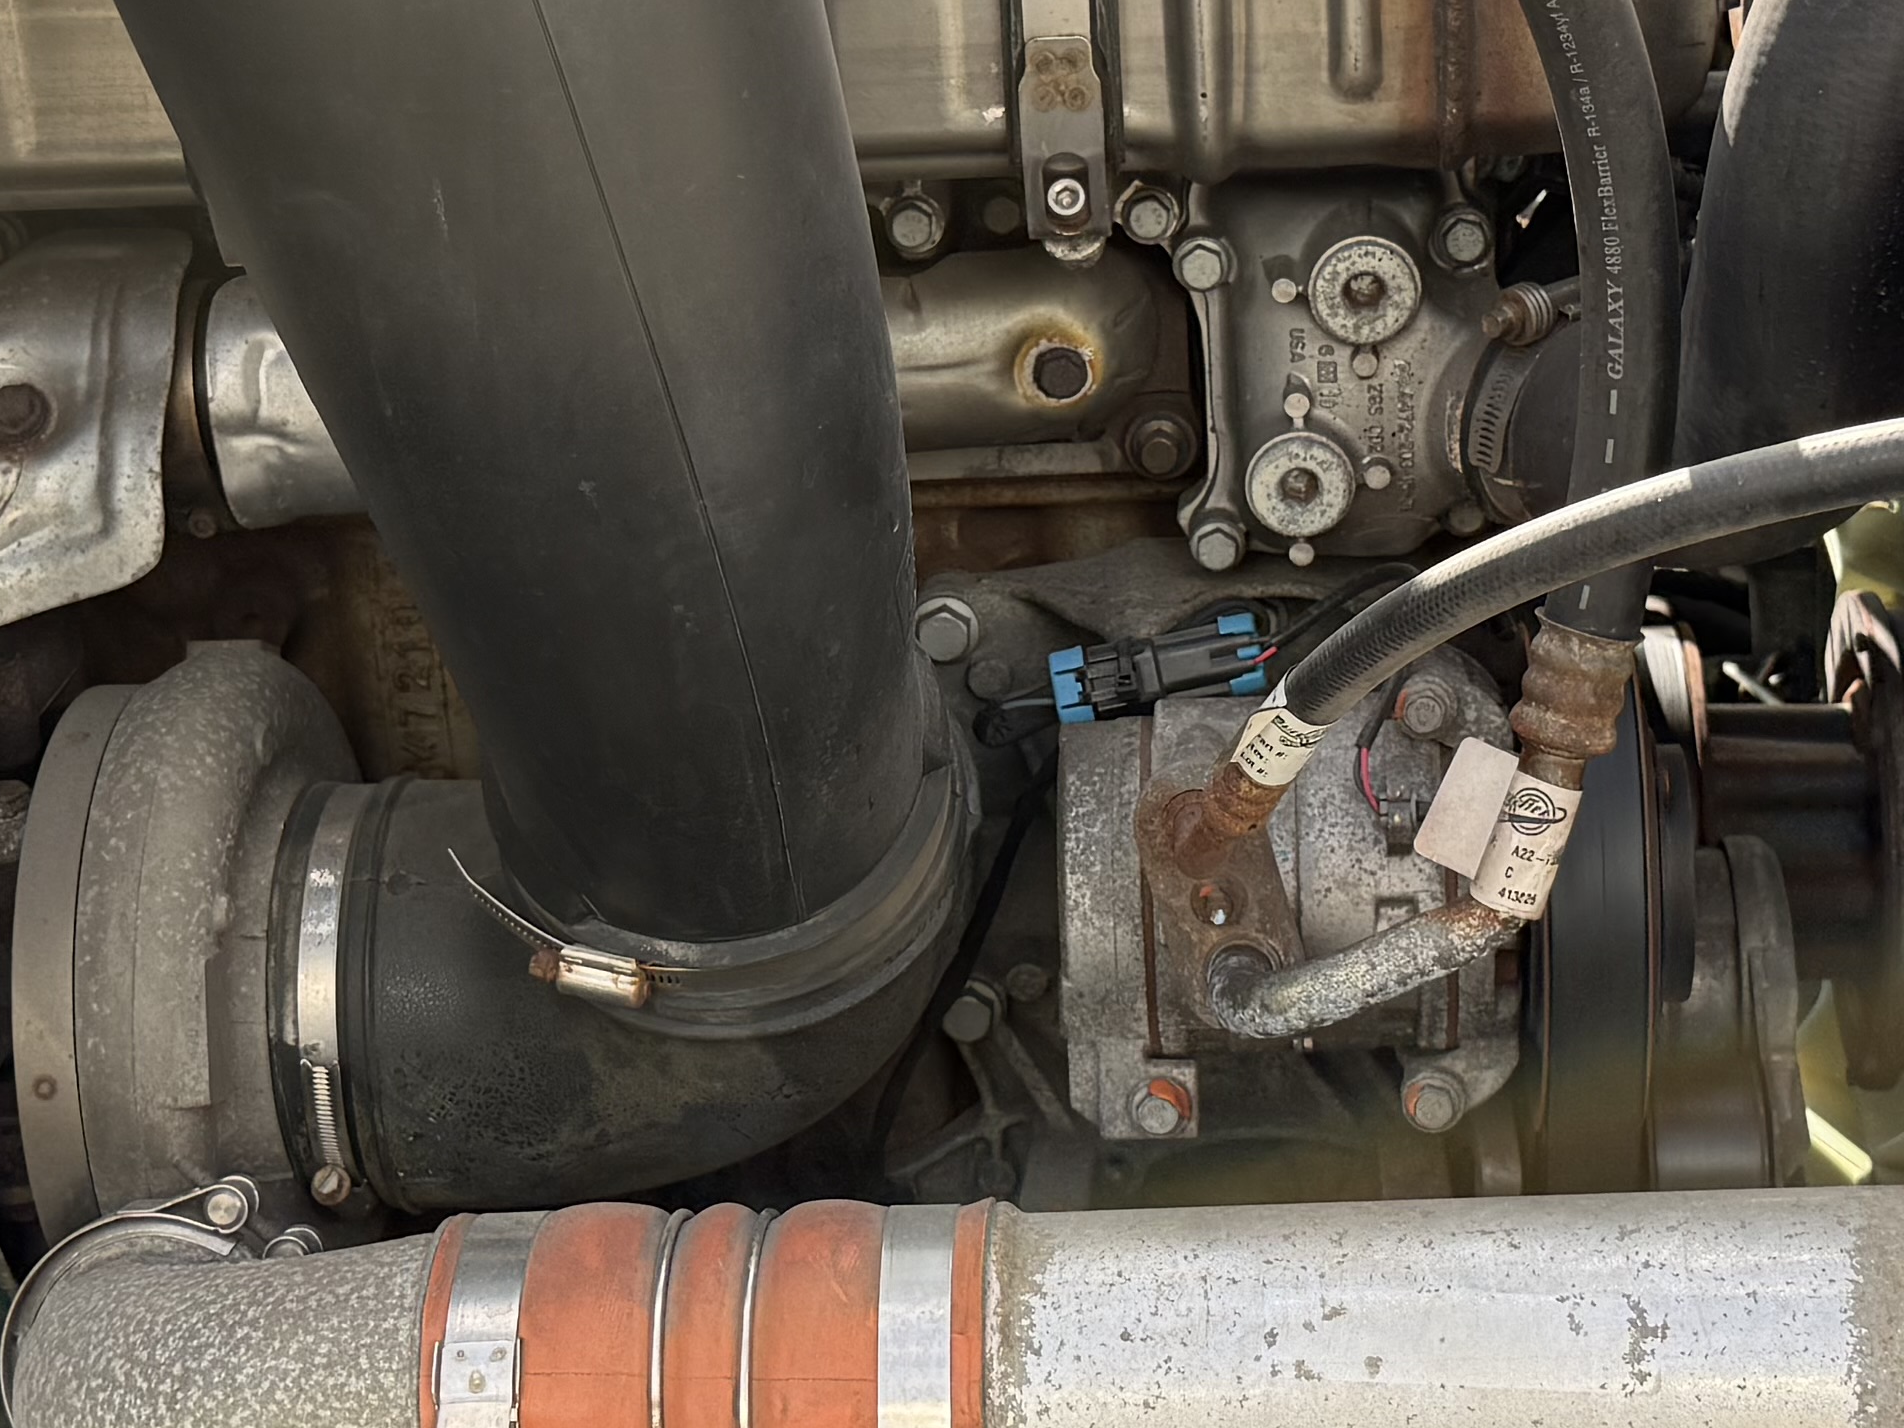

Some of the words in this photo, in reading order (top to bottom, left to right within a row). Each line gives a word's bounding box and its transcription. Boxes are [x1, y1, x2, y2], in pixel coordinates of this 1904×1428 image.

[1550, 12, 1583, 75] R-1234yf
[1579, 86, 1601, 138] R-134a
[1605, 234, 1622, 275] 4880
[1289, 327, 1306, 363] USA
[1606, 280, 1624, 380] GALAXY
[1504, 866, 1514, 878] C
